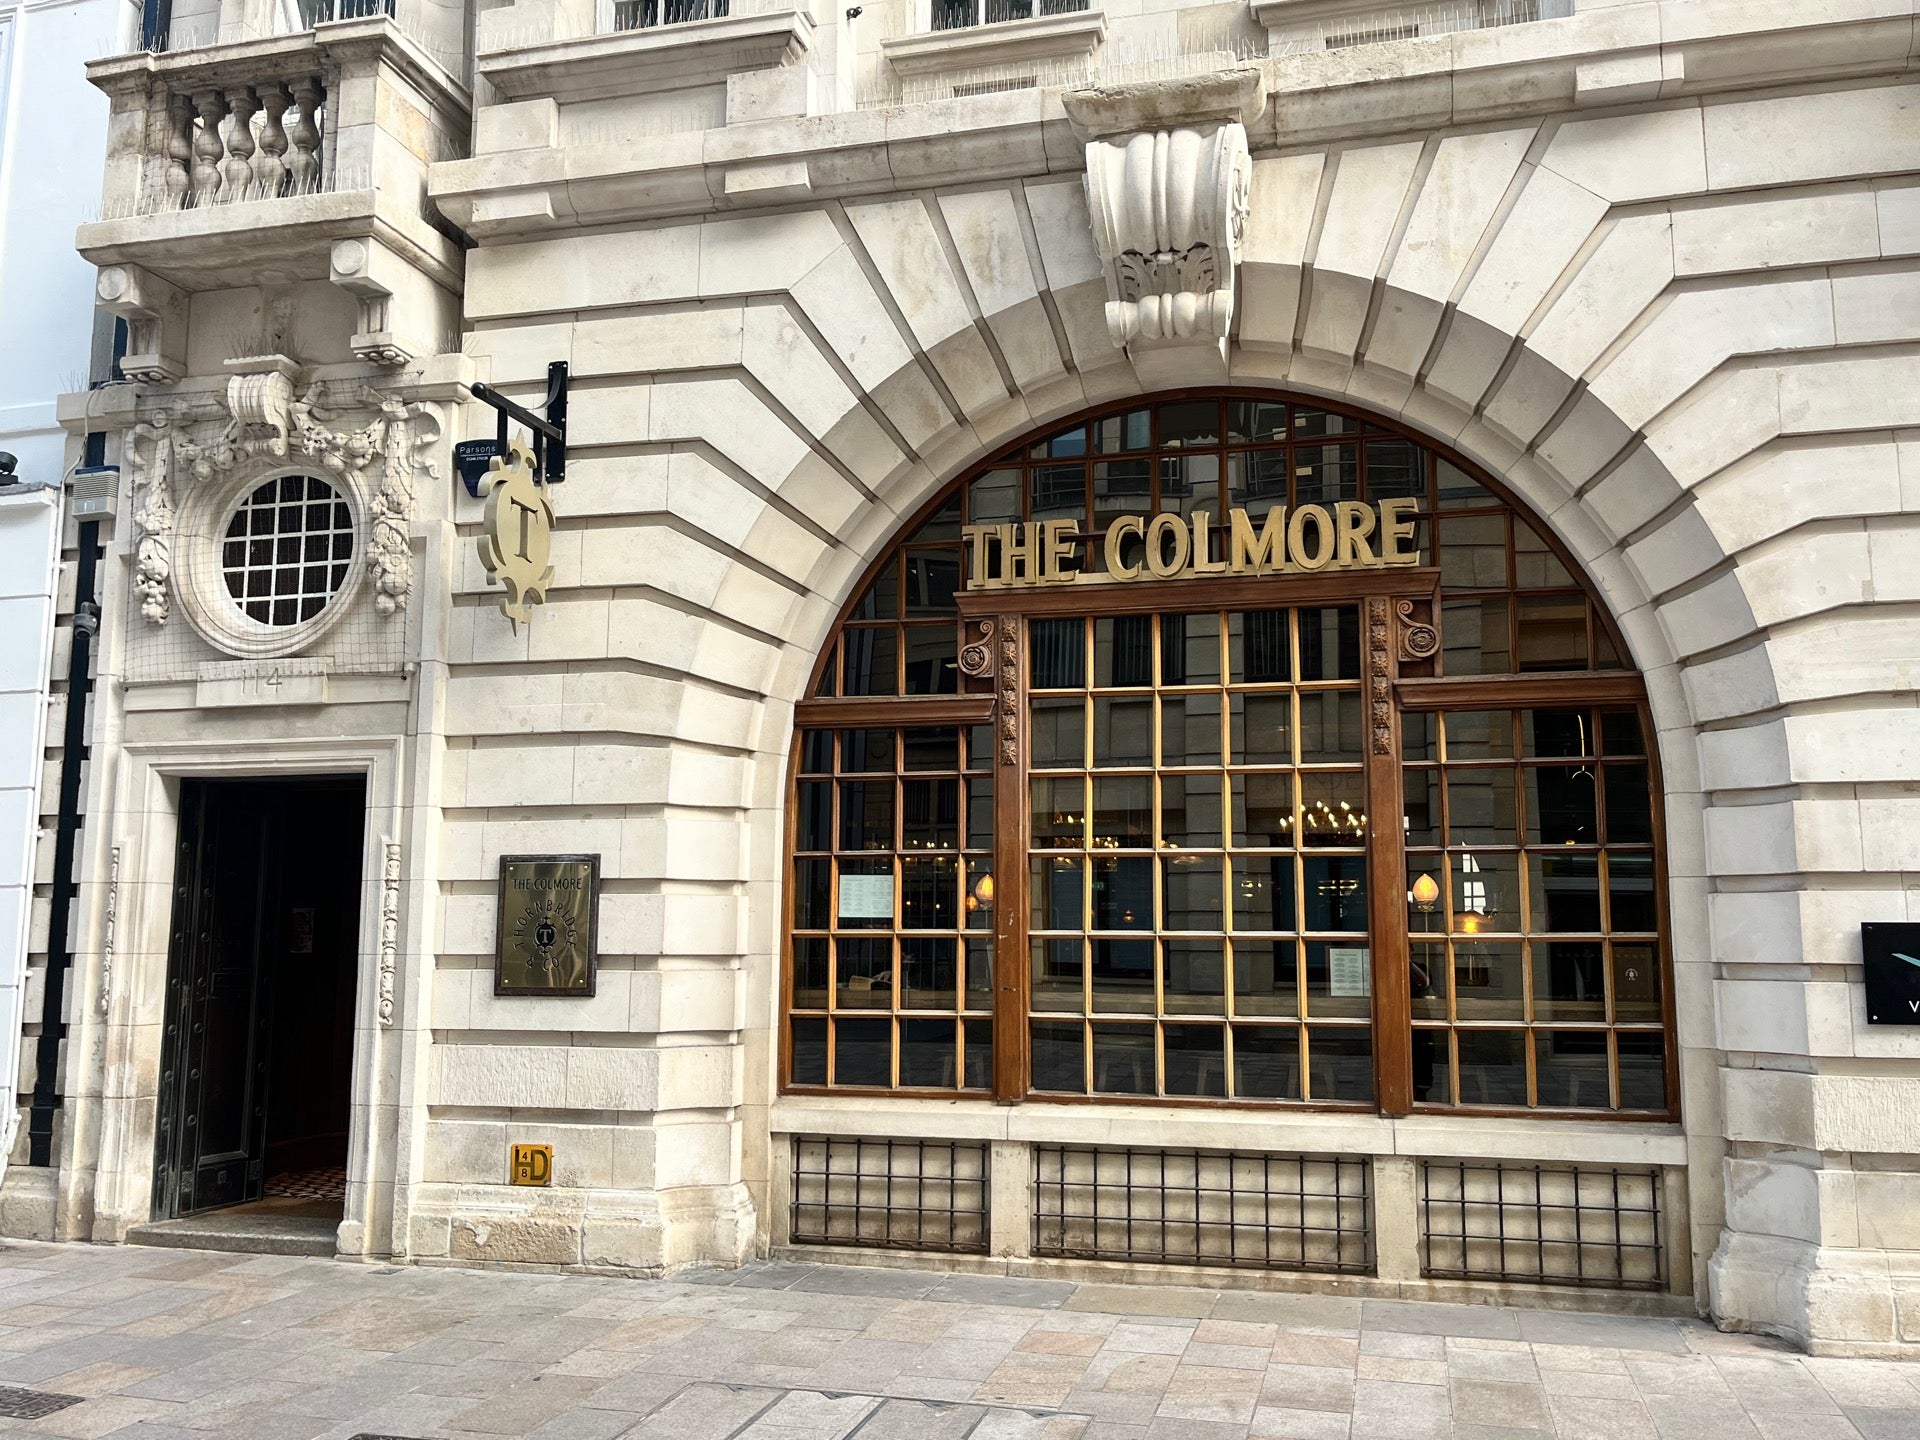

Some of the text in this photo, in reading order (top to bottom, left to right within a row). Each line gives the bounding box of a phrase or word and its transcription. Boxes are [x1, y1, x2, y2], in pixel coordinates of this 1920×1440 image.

[459, 446, 496, 454] Parsons
[510, 496, 539, 563] T
[961, 496, 1421, 587] THE COLMORE
[240, 667, 283, 695] 114
[512, 878, 582, 890] THE COLMORE
[512, 899, 579, 951] THORNBRIDGE
[539, 929, 552, 943] T
[526, 956, 560, 971] & CO
[522, 1152, 528, 1160] 4
[522, 1168, 528, 1178] 8
